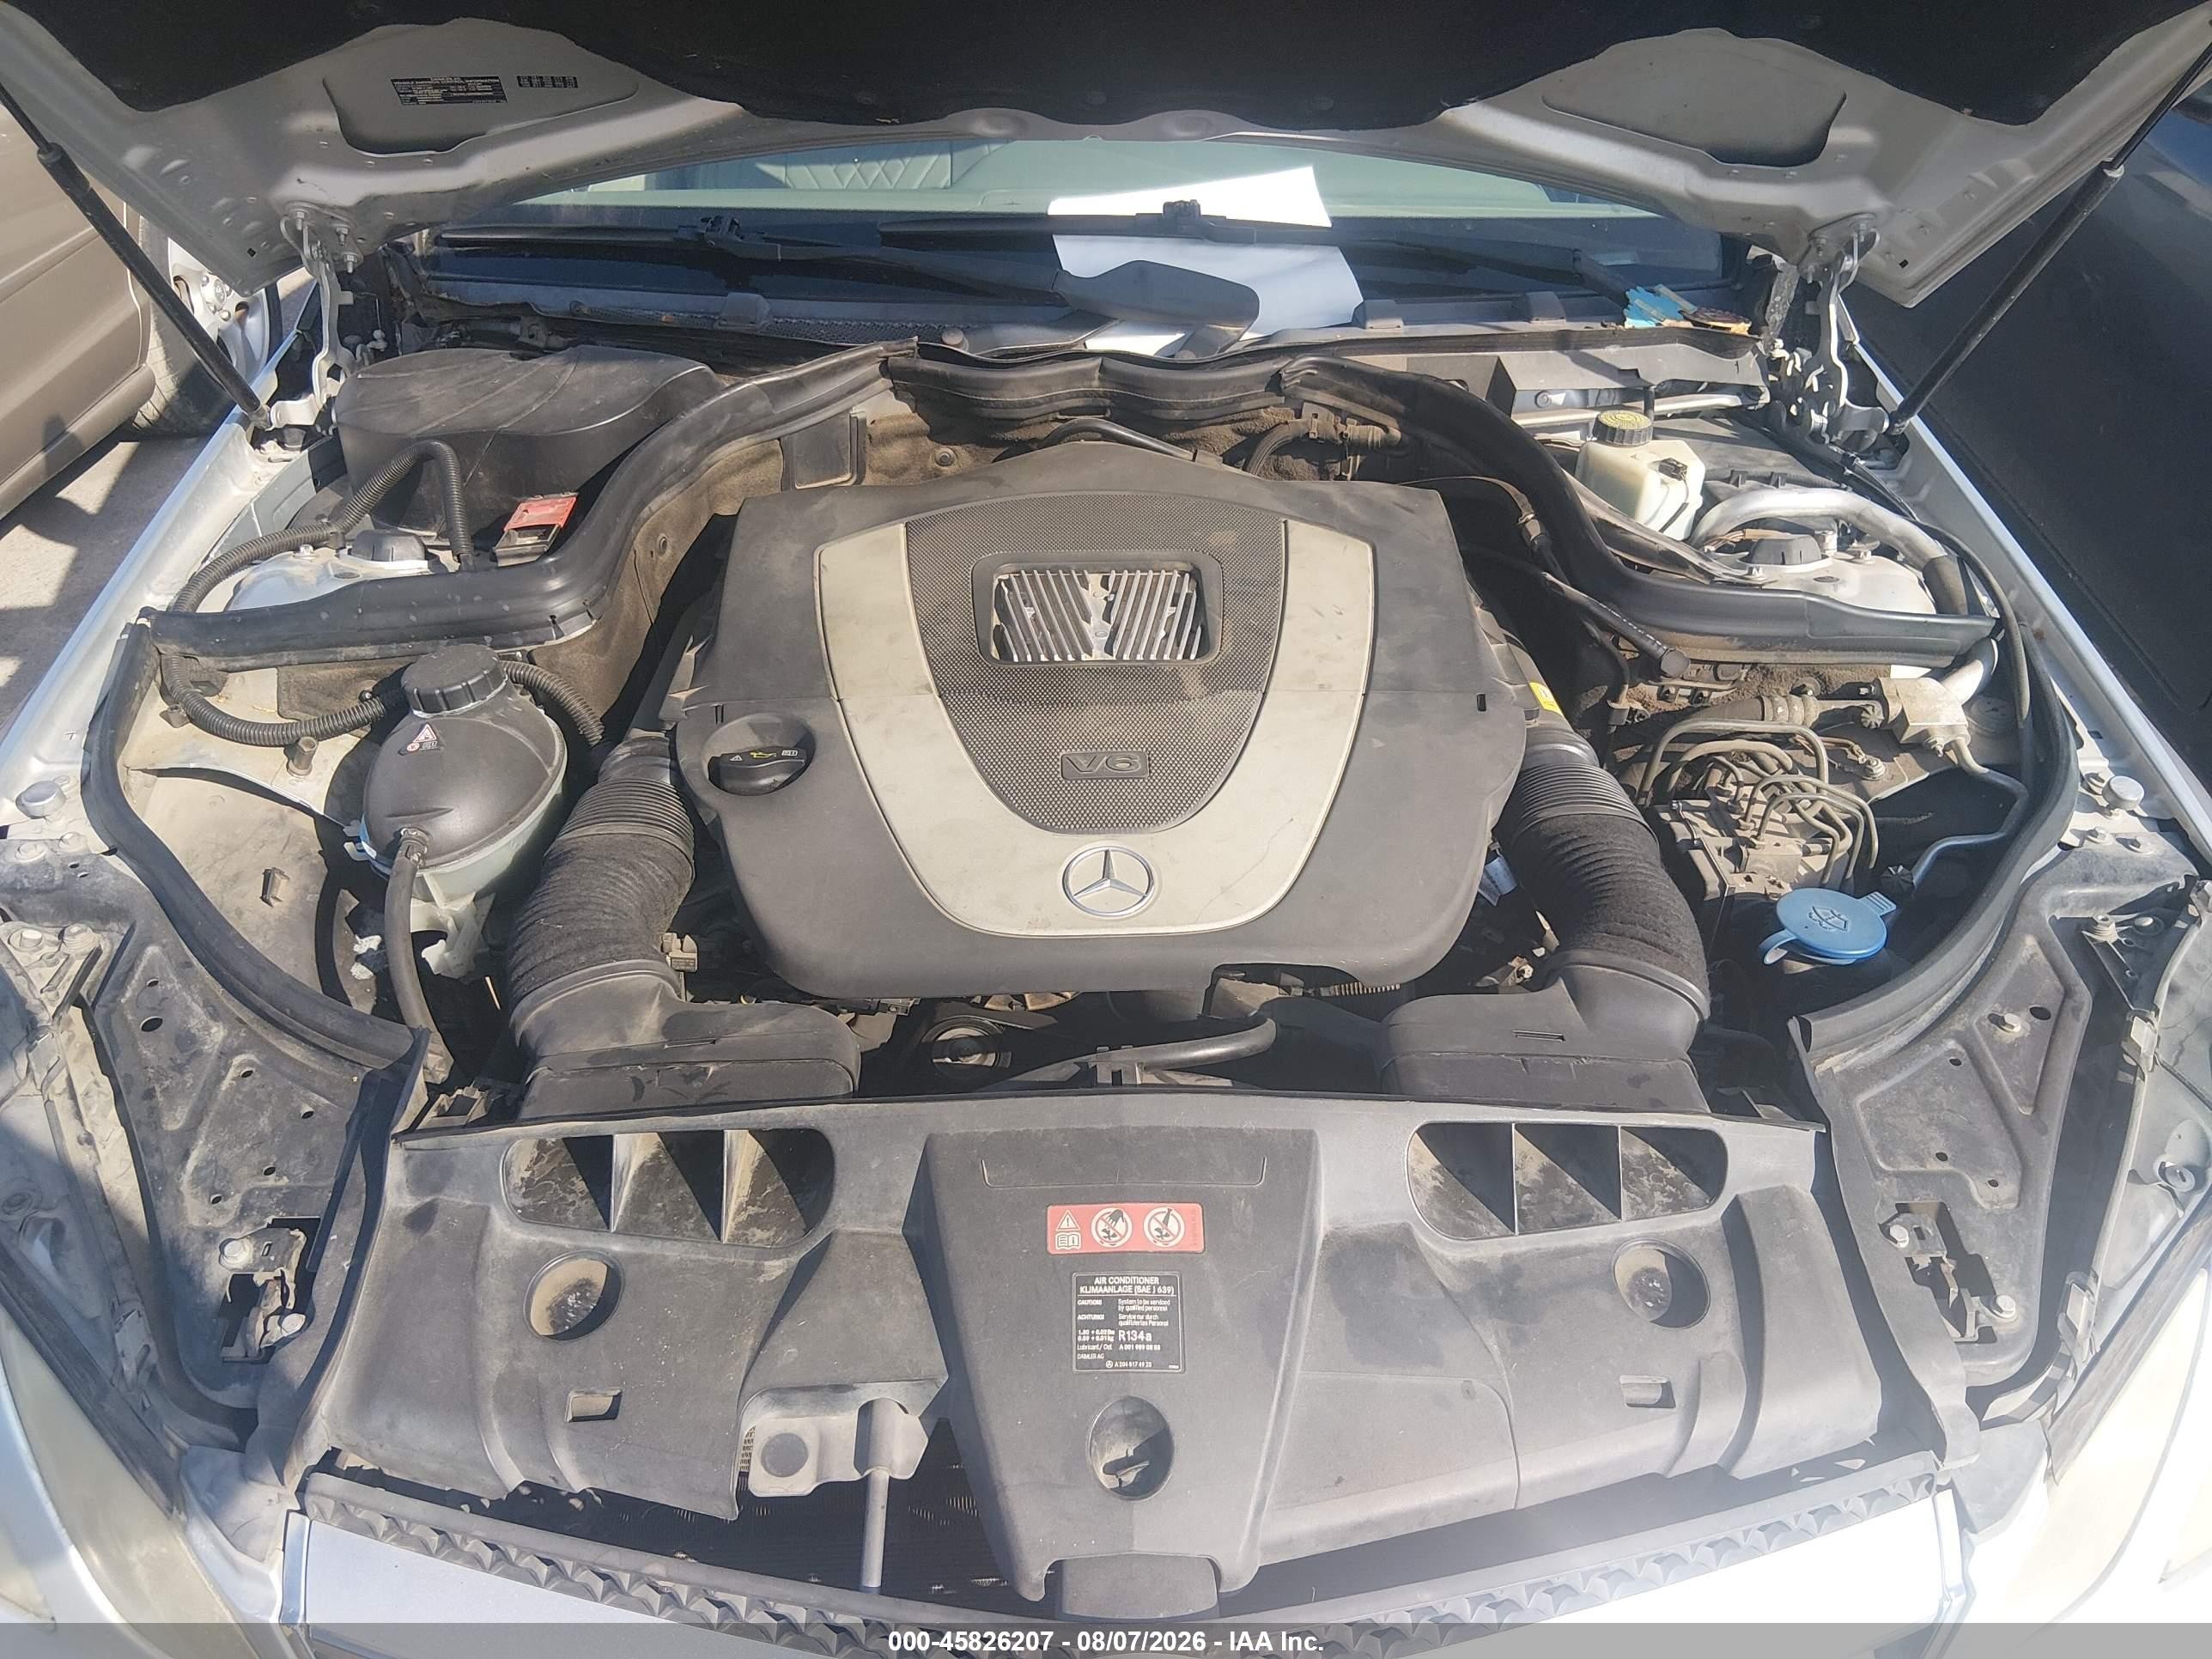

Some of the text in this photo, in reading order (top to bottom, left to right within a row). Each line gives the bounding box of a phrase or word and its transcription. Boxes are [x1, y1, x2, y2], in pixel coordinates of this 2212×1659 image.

[1065, 755, 1141, 774] V6
[1094, 1276, 1159, 1285] AIR CONDITIONER
[1079, 1285, 1133, 1294] KLIMAANLAGE
[1134, 1285, 1152, 1295] (SAE
[1157, 1285, 1175, 1295] 639)
[1118, 1329, 1152, 1341] R134a
